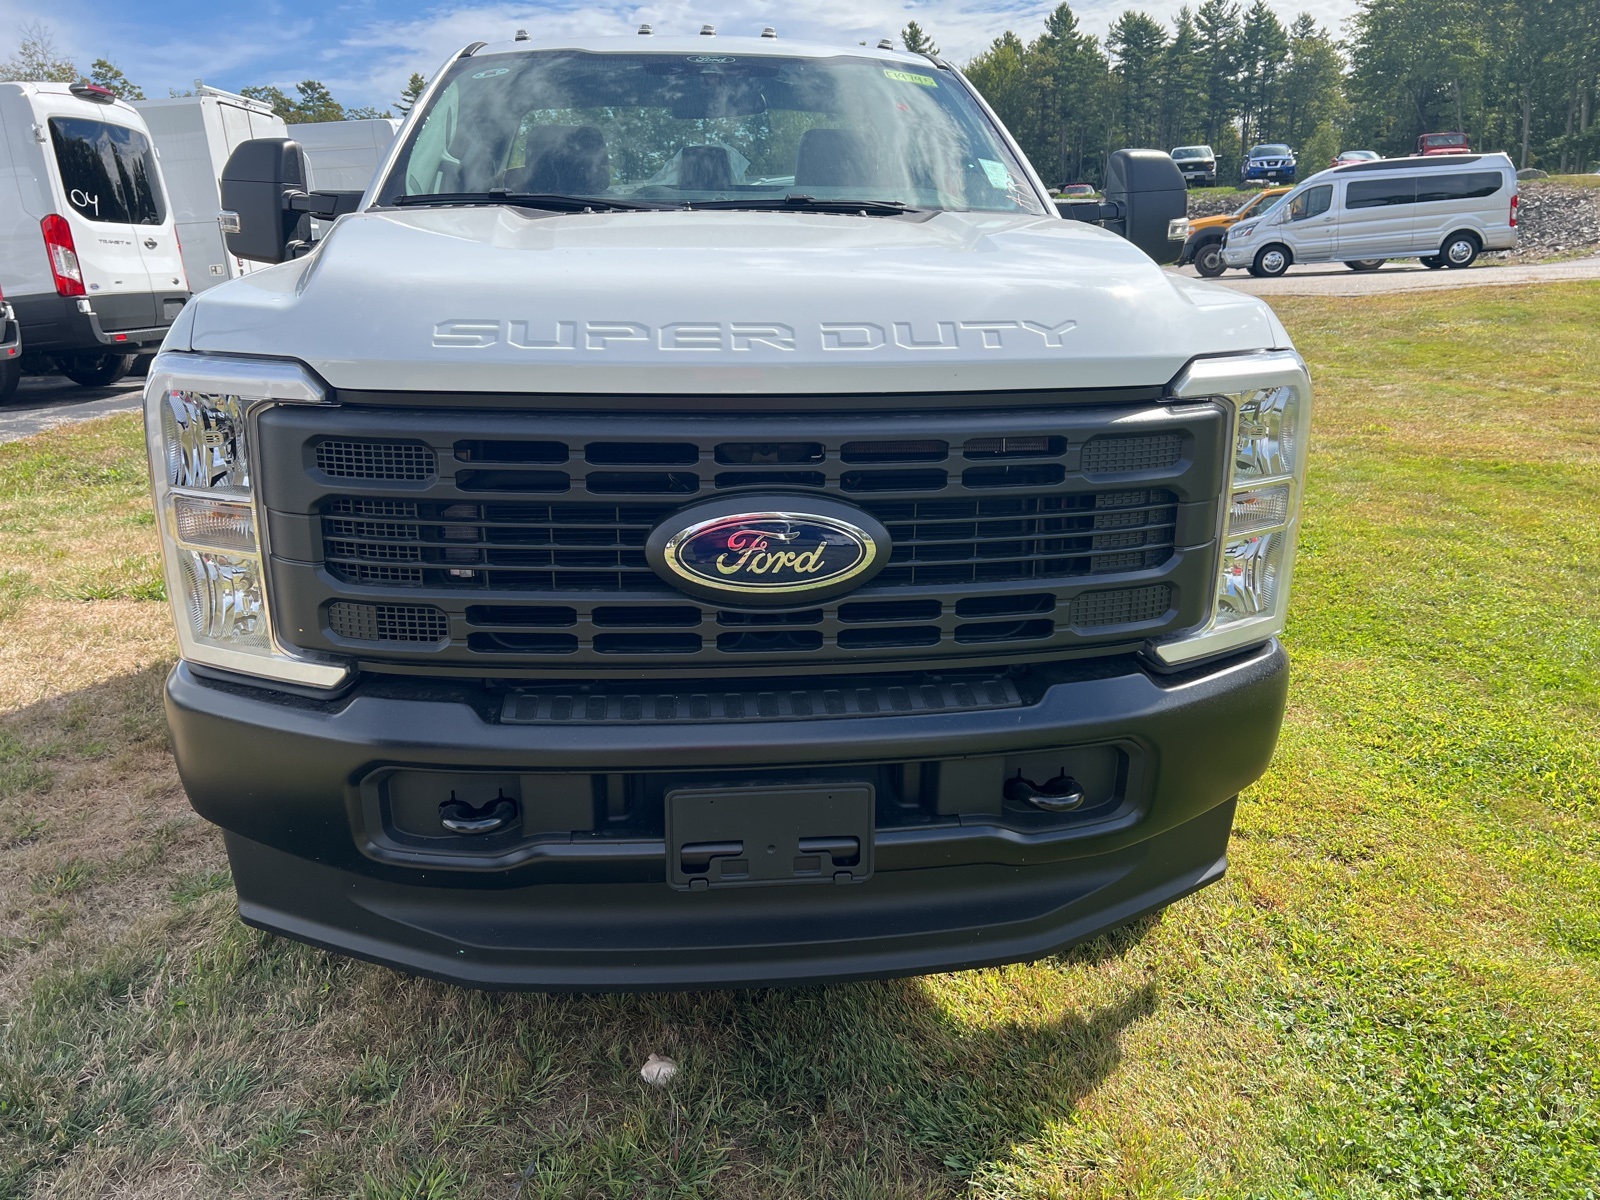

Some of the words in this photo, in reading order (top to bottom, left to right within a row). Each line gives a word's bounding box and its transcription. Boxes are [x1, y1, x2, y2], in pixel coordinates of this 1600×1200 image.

[432, 318, 796, 350] SUPER
[820, 319, 1077, 350] DUTY
[716, 529, 828, 574] Ford
